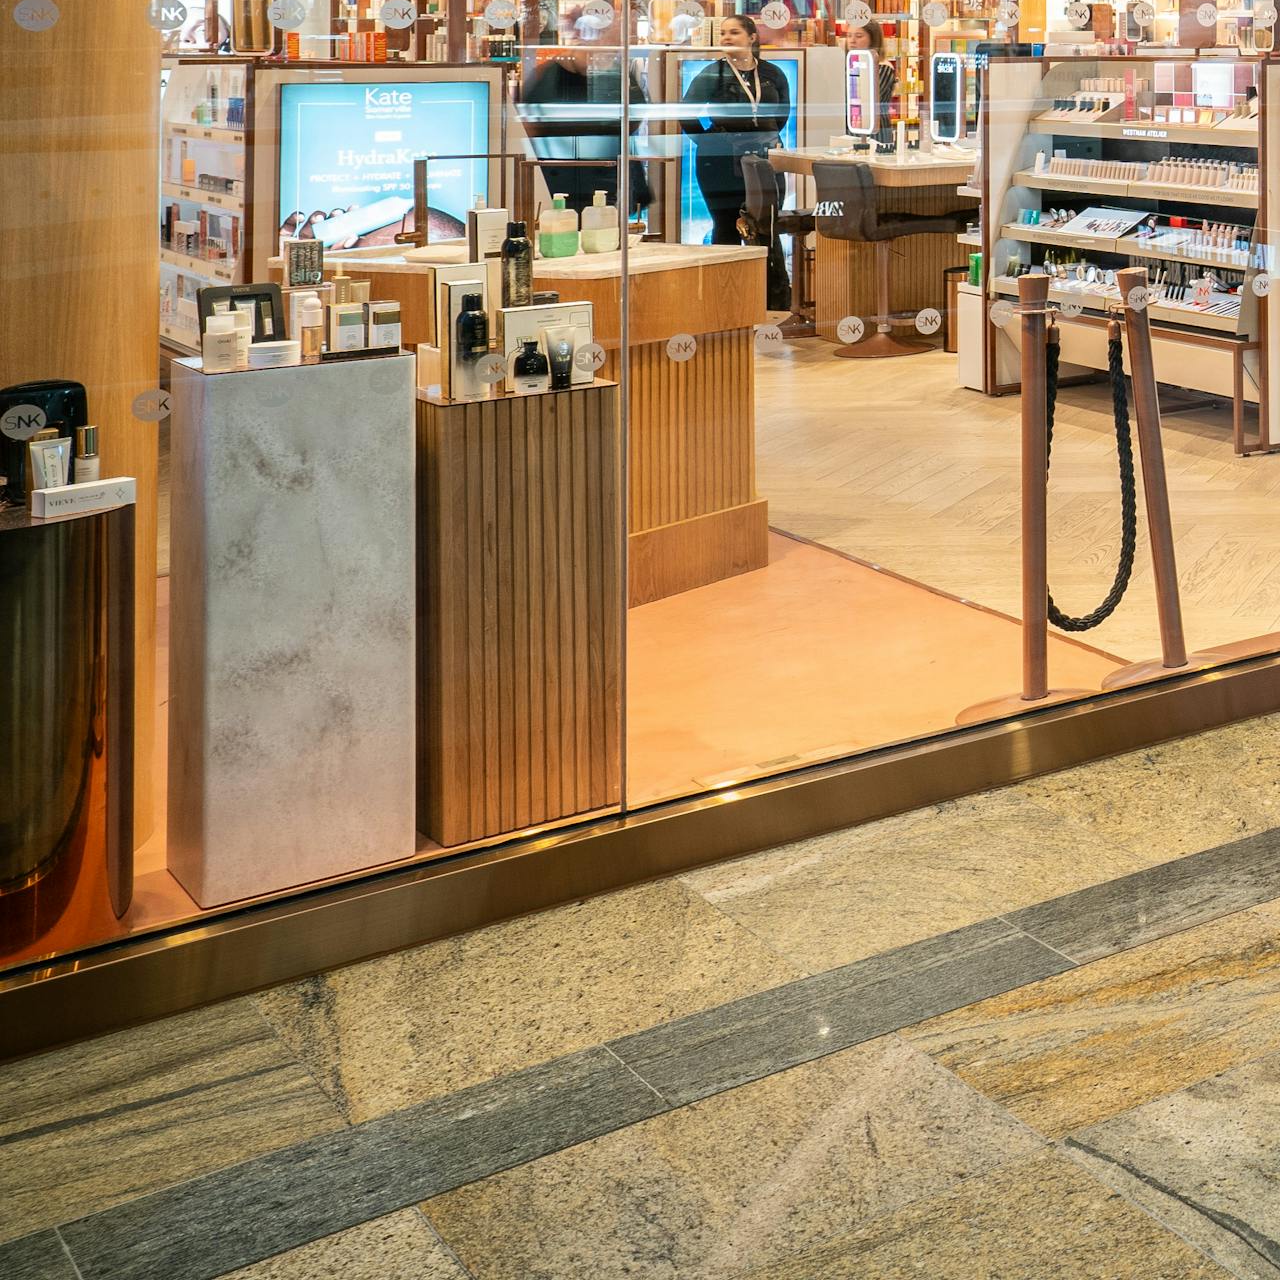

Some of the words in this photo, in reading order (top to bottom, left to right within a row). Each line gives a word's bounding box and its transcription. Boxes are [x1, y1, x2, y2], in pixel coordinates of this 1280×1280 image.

[384, 7, 412, 20] SNK
[765, 9, 787, 20] SNK
[848, 9, 869, 20] SNK
[365, 87, 413, 106] Kate
[918, 315, 939, 326] SNK
[839, 324, 862, 334] SNK
[668, 342, 692, 354] SNK
[577, 351, 603, 364] SNK
[5, 413, 41, 431] SNK
